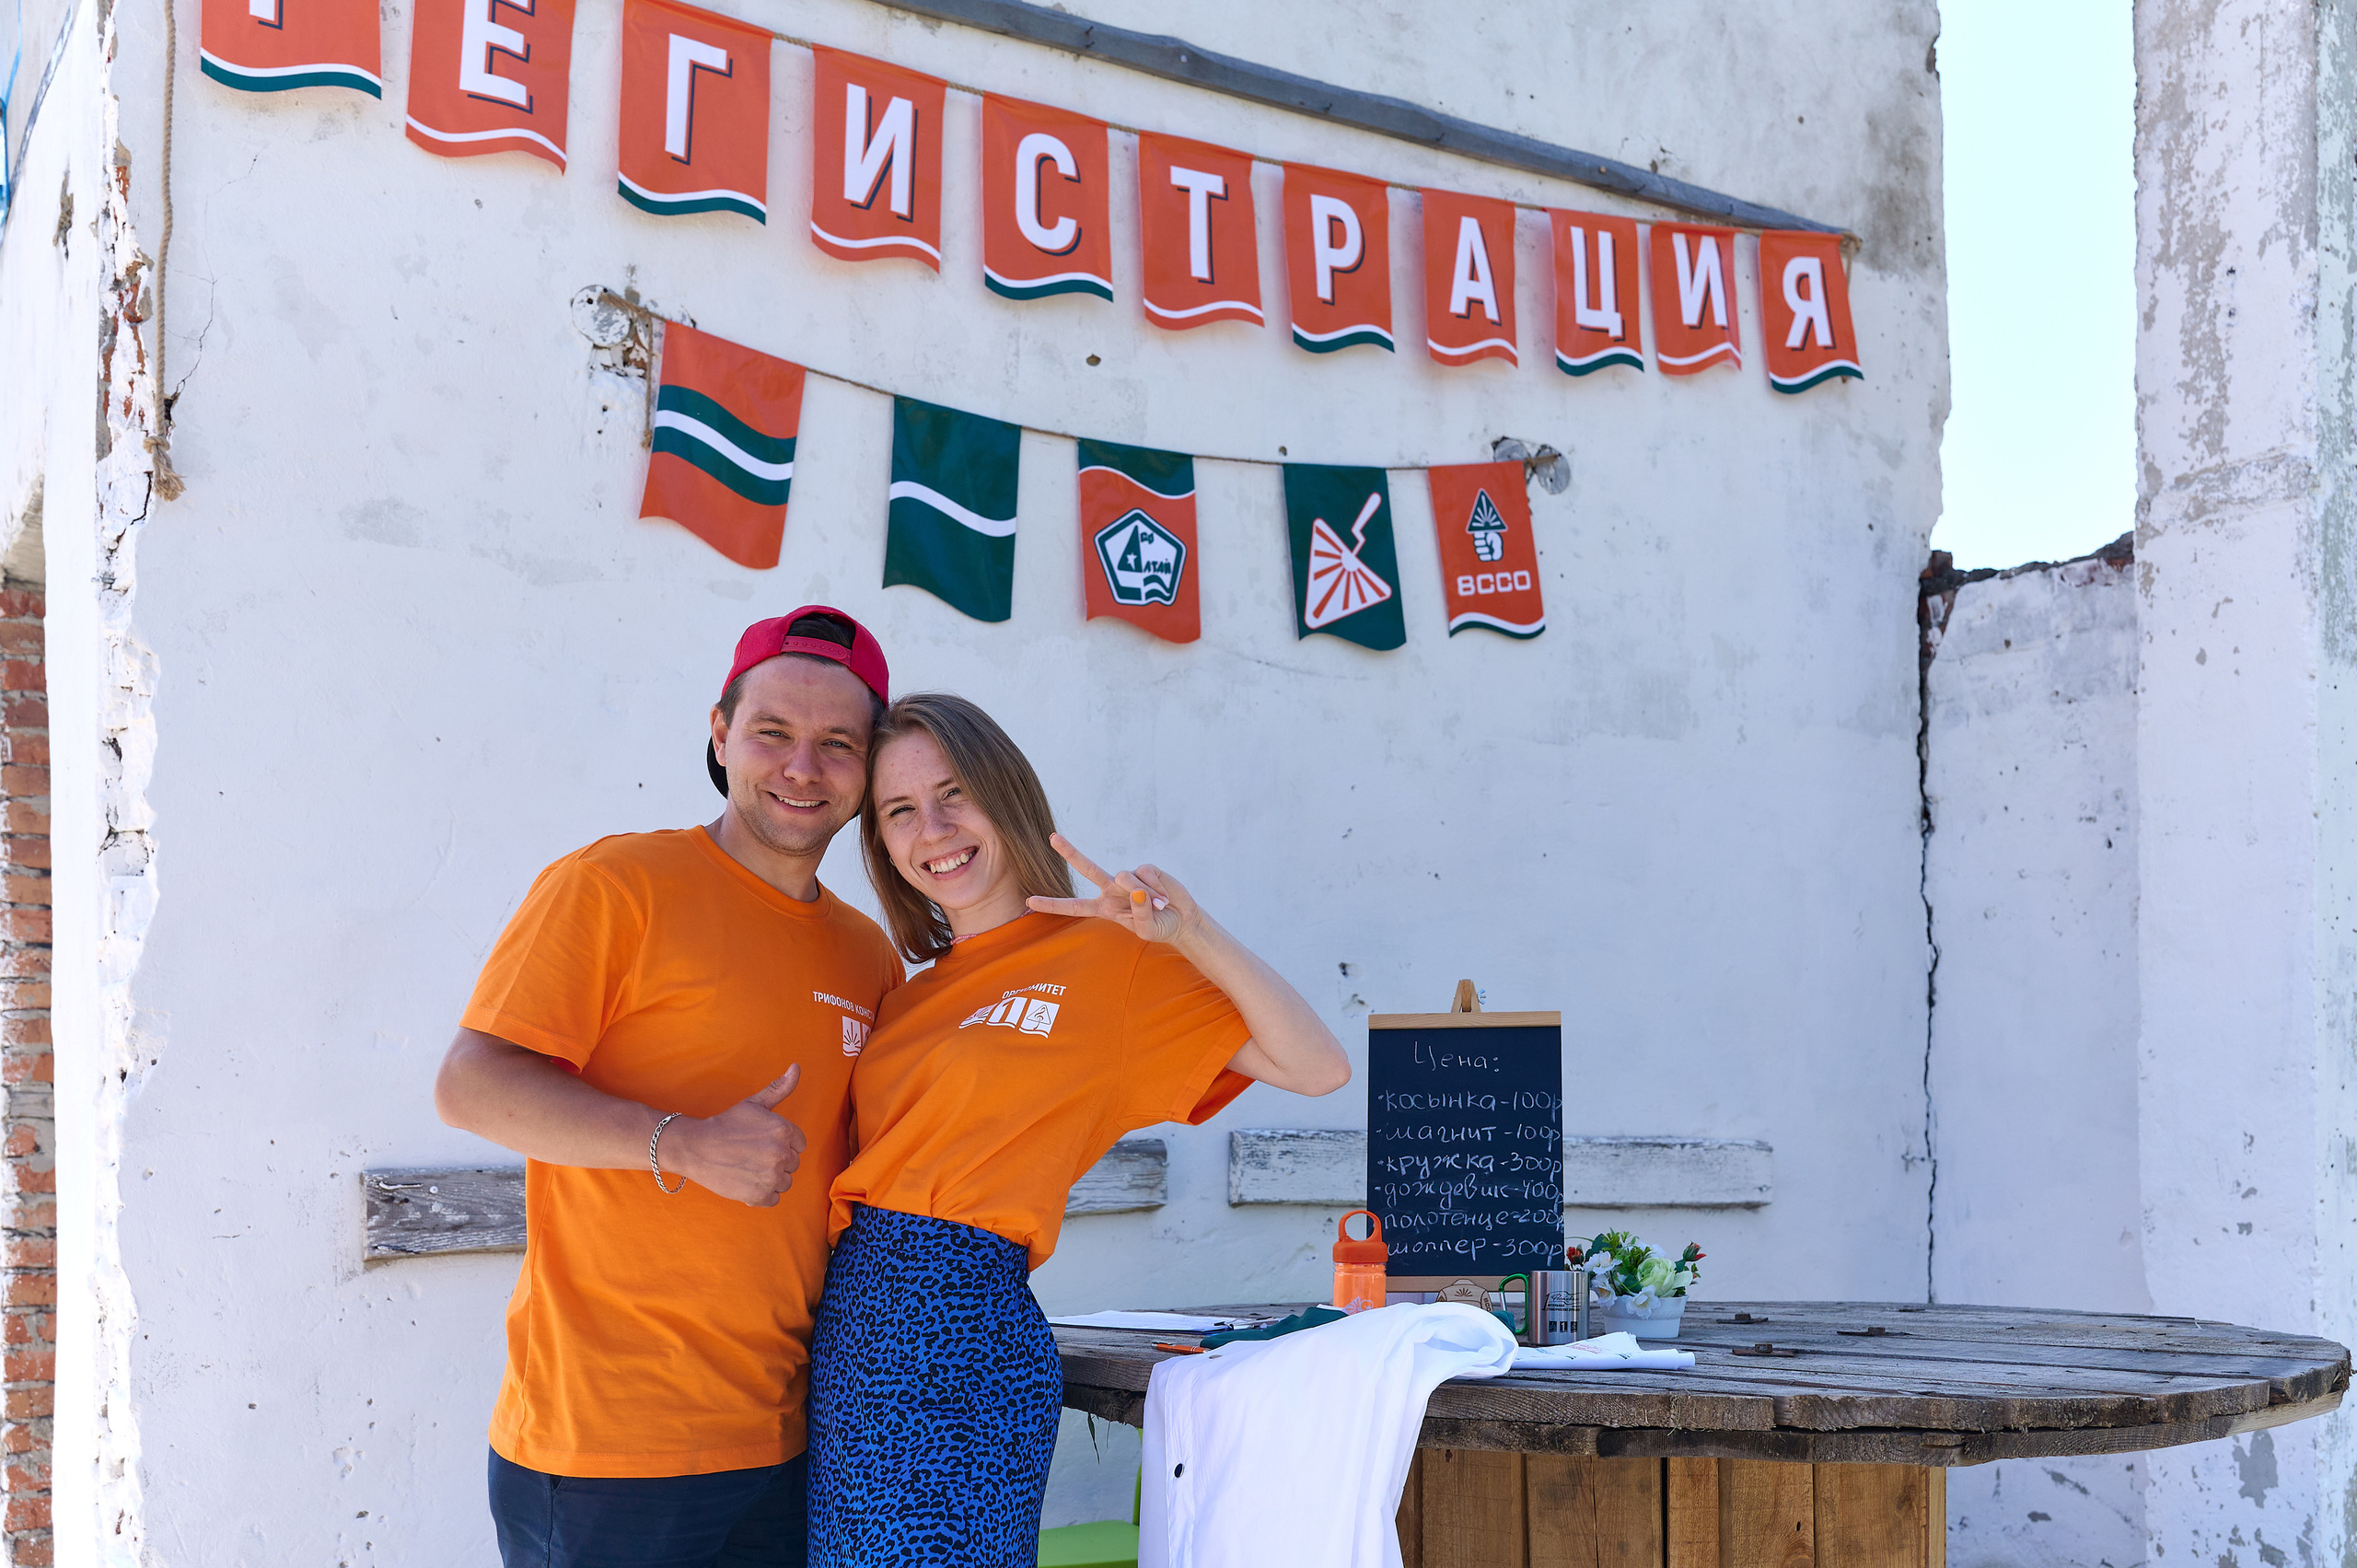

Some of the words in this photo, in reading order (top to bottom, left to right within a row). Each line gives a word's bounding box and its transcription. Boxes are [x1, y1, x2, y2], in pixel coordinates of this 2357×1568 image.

[250, 0, 1836, 350] ЕГИСТРАЦИЯ
[1457, 570, 1531, 597] ВССО
[813, 991, 854, 1012] ТРИФОНОВ
[1414, 1040, 1500, 1073] Цена:
